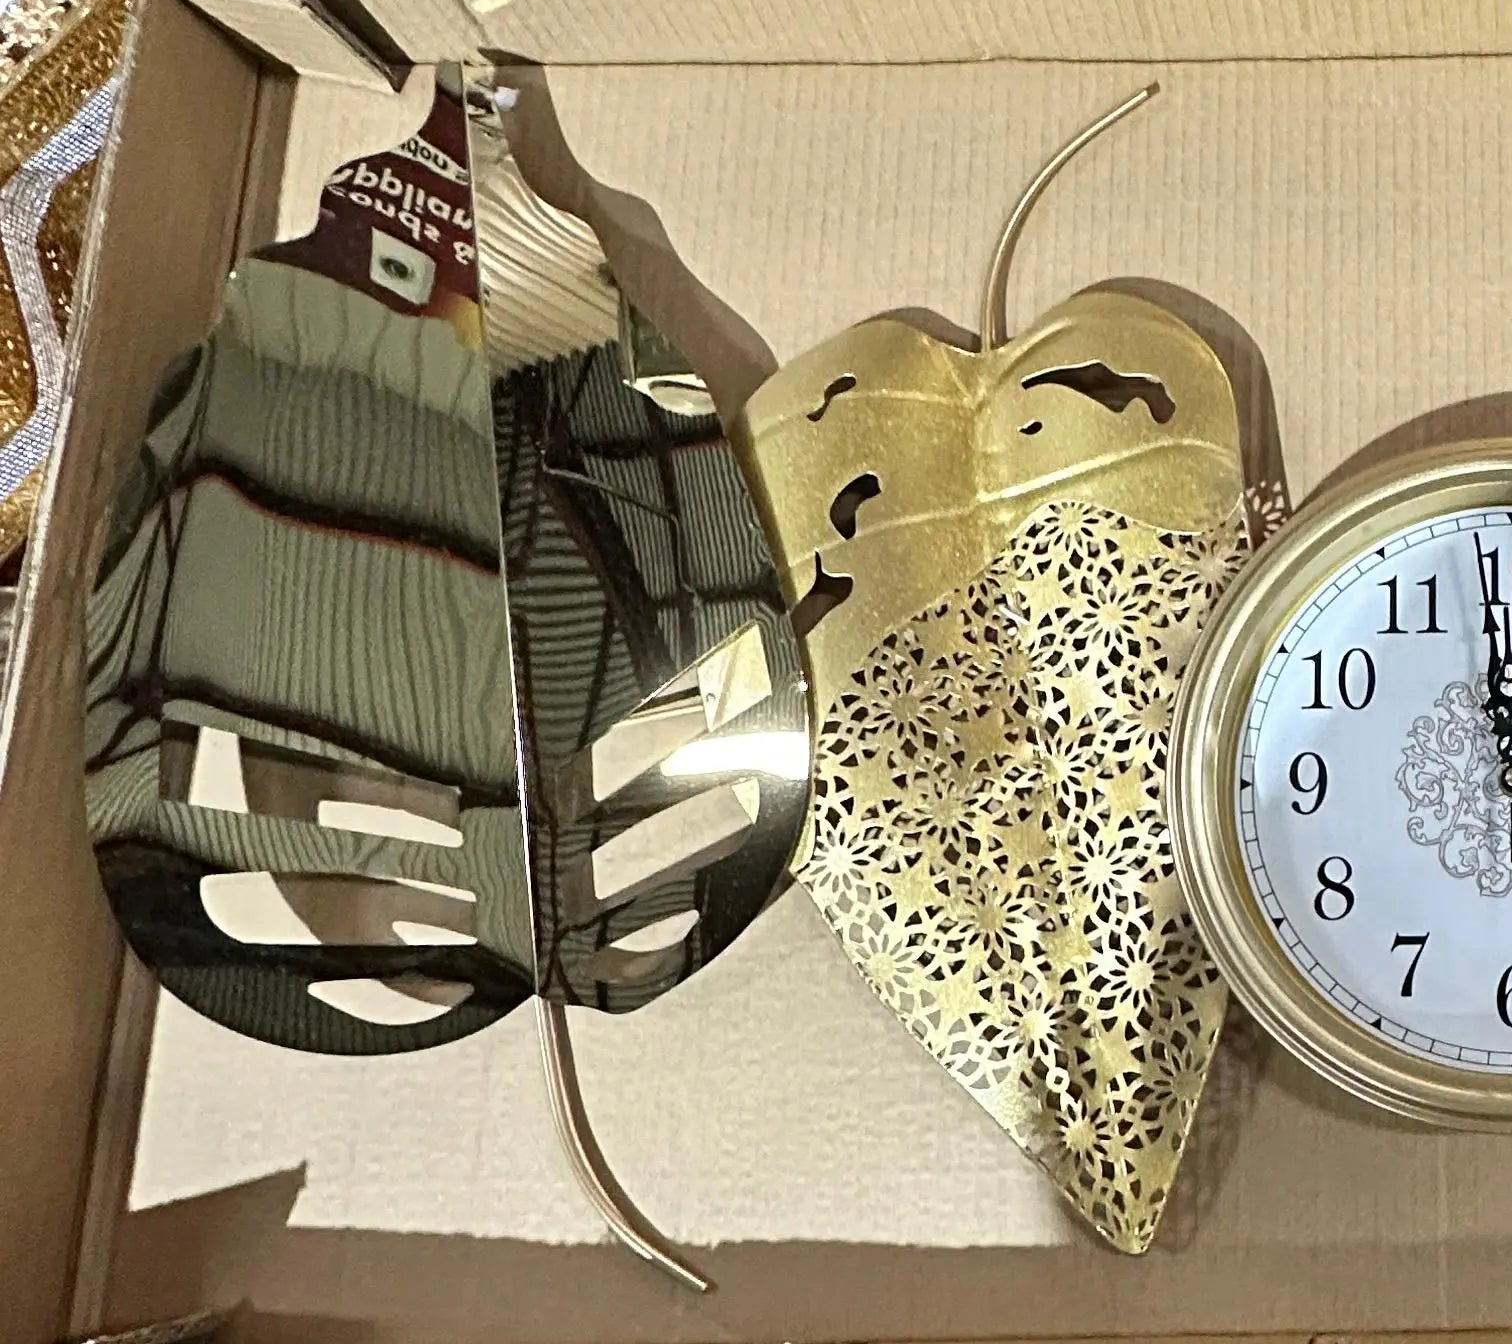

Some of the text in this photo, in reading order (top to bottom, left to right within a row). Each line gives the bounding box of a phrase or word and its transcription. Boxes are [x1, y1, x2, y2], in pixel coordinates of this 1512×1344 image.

[1376, 574, 1449, 635] 11
[1300, 648, 1376, 710] 10
[1288, 752, 1328, 815] 9
[1313, 856, 1356, 921] 8
[1390, 932, 1430, 997] 7
